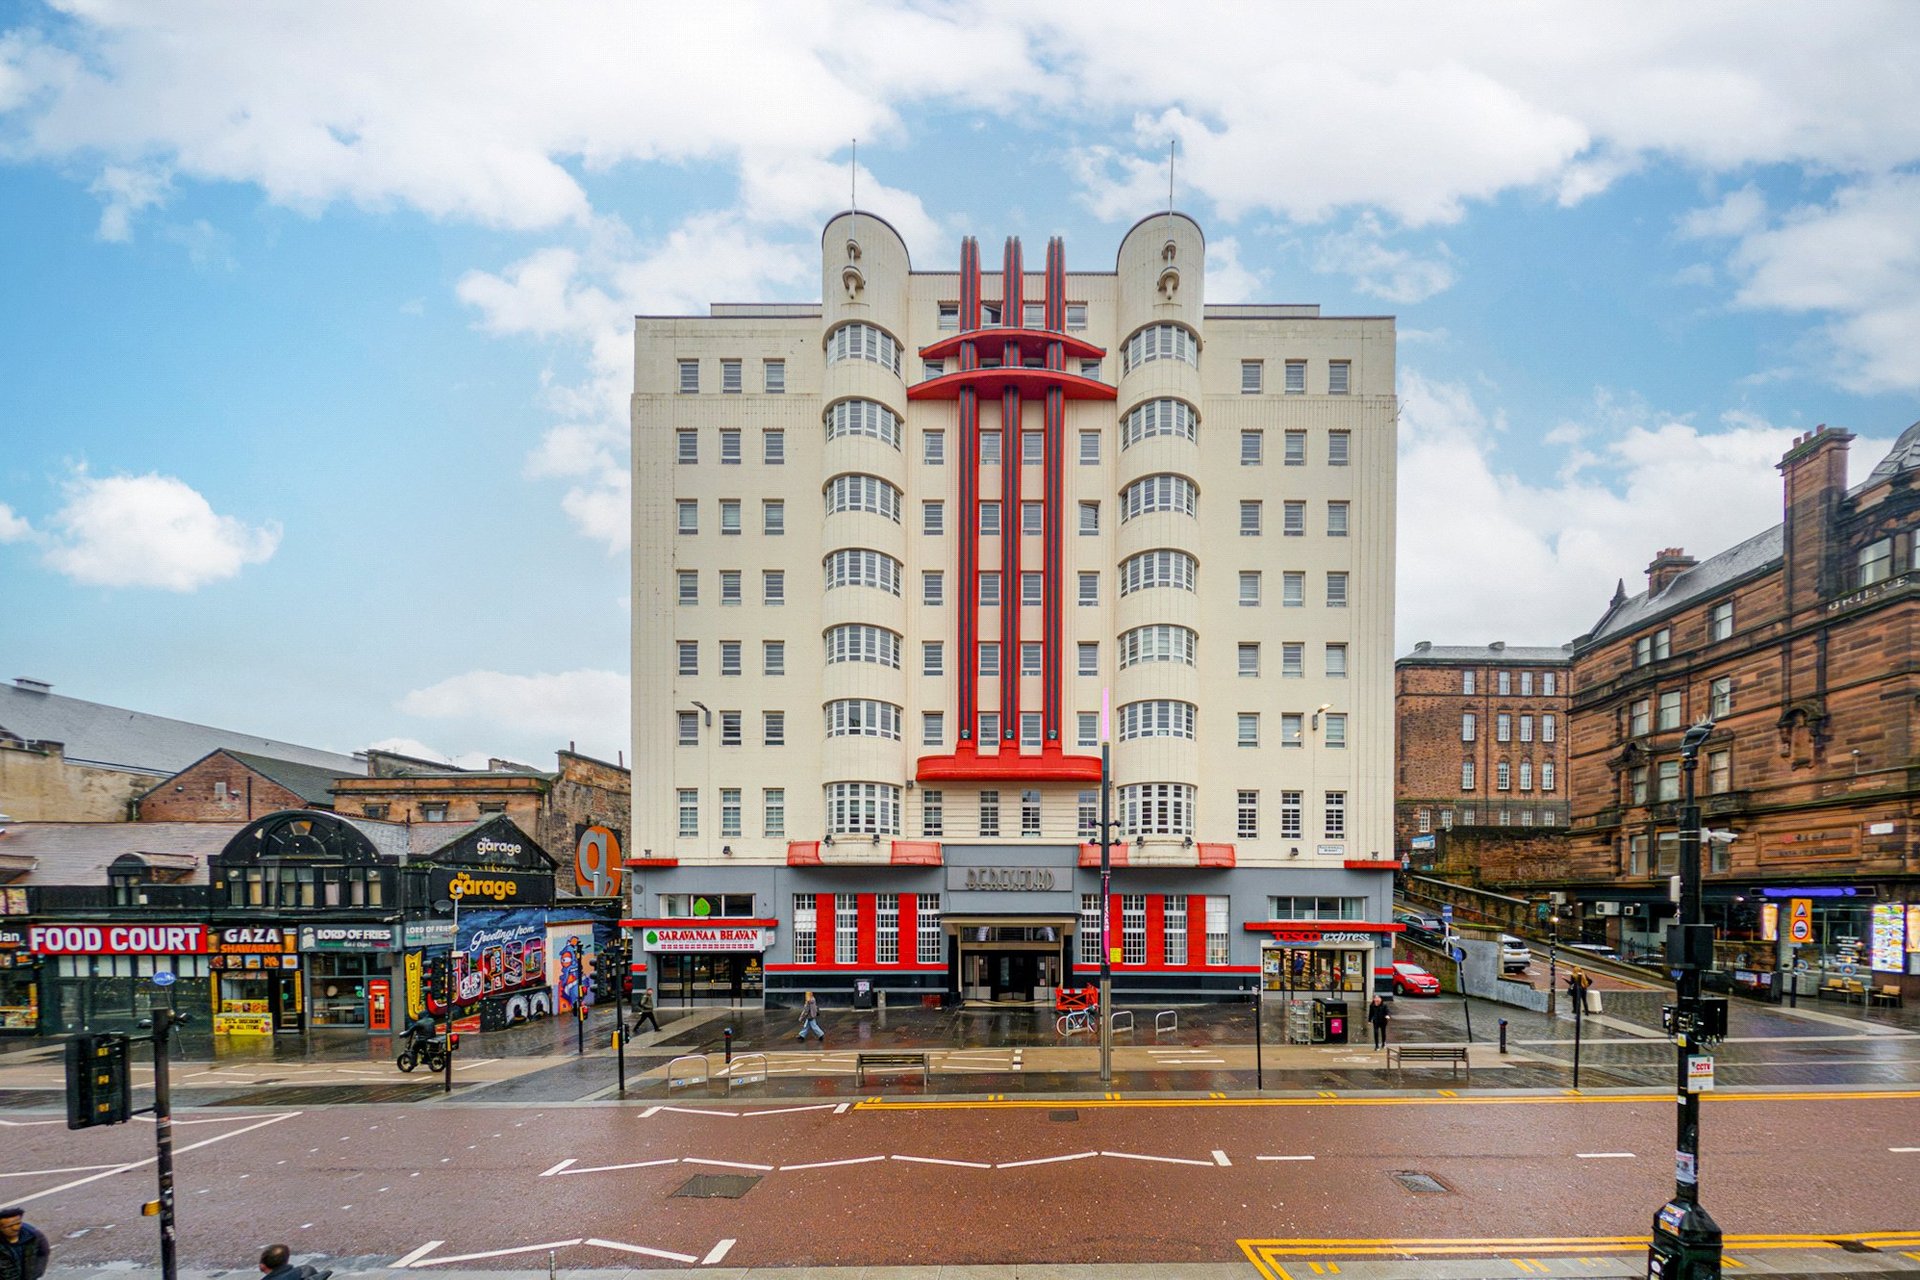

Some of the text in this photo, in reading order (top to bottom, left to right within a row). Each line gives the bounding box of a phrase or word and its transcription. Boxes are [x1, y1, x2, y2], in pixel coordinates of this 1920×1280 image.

[477, 841, 521, 856] garage
[457, 872, 470, 880] the
[449, 879, 517, 900] garage
[224, 928, 280, 943] GAZA
[317, 929, 391, 939] LORD OF FRIES
[406, 926, 424, 934] LORD
[659, 930, 758, 941] SARAVANAA BHAVAN
[30, 927, 200, 951] FOOD COURT
[470, 925, 535, 951] Greetings from
[1272, 931, 1320, 942] TESCO
[1323, 932, 1370, 943] express
[220, 943, 283, 953] SHAWARMA
[1696, 1063, 1711, 1071] CCTV
